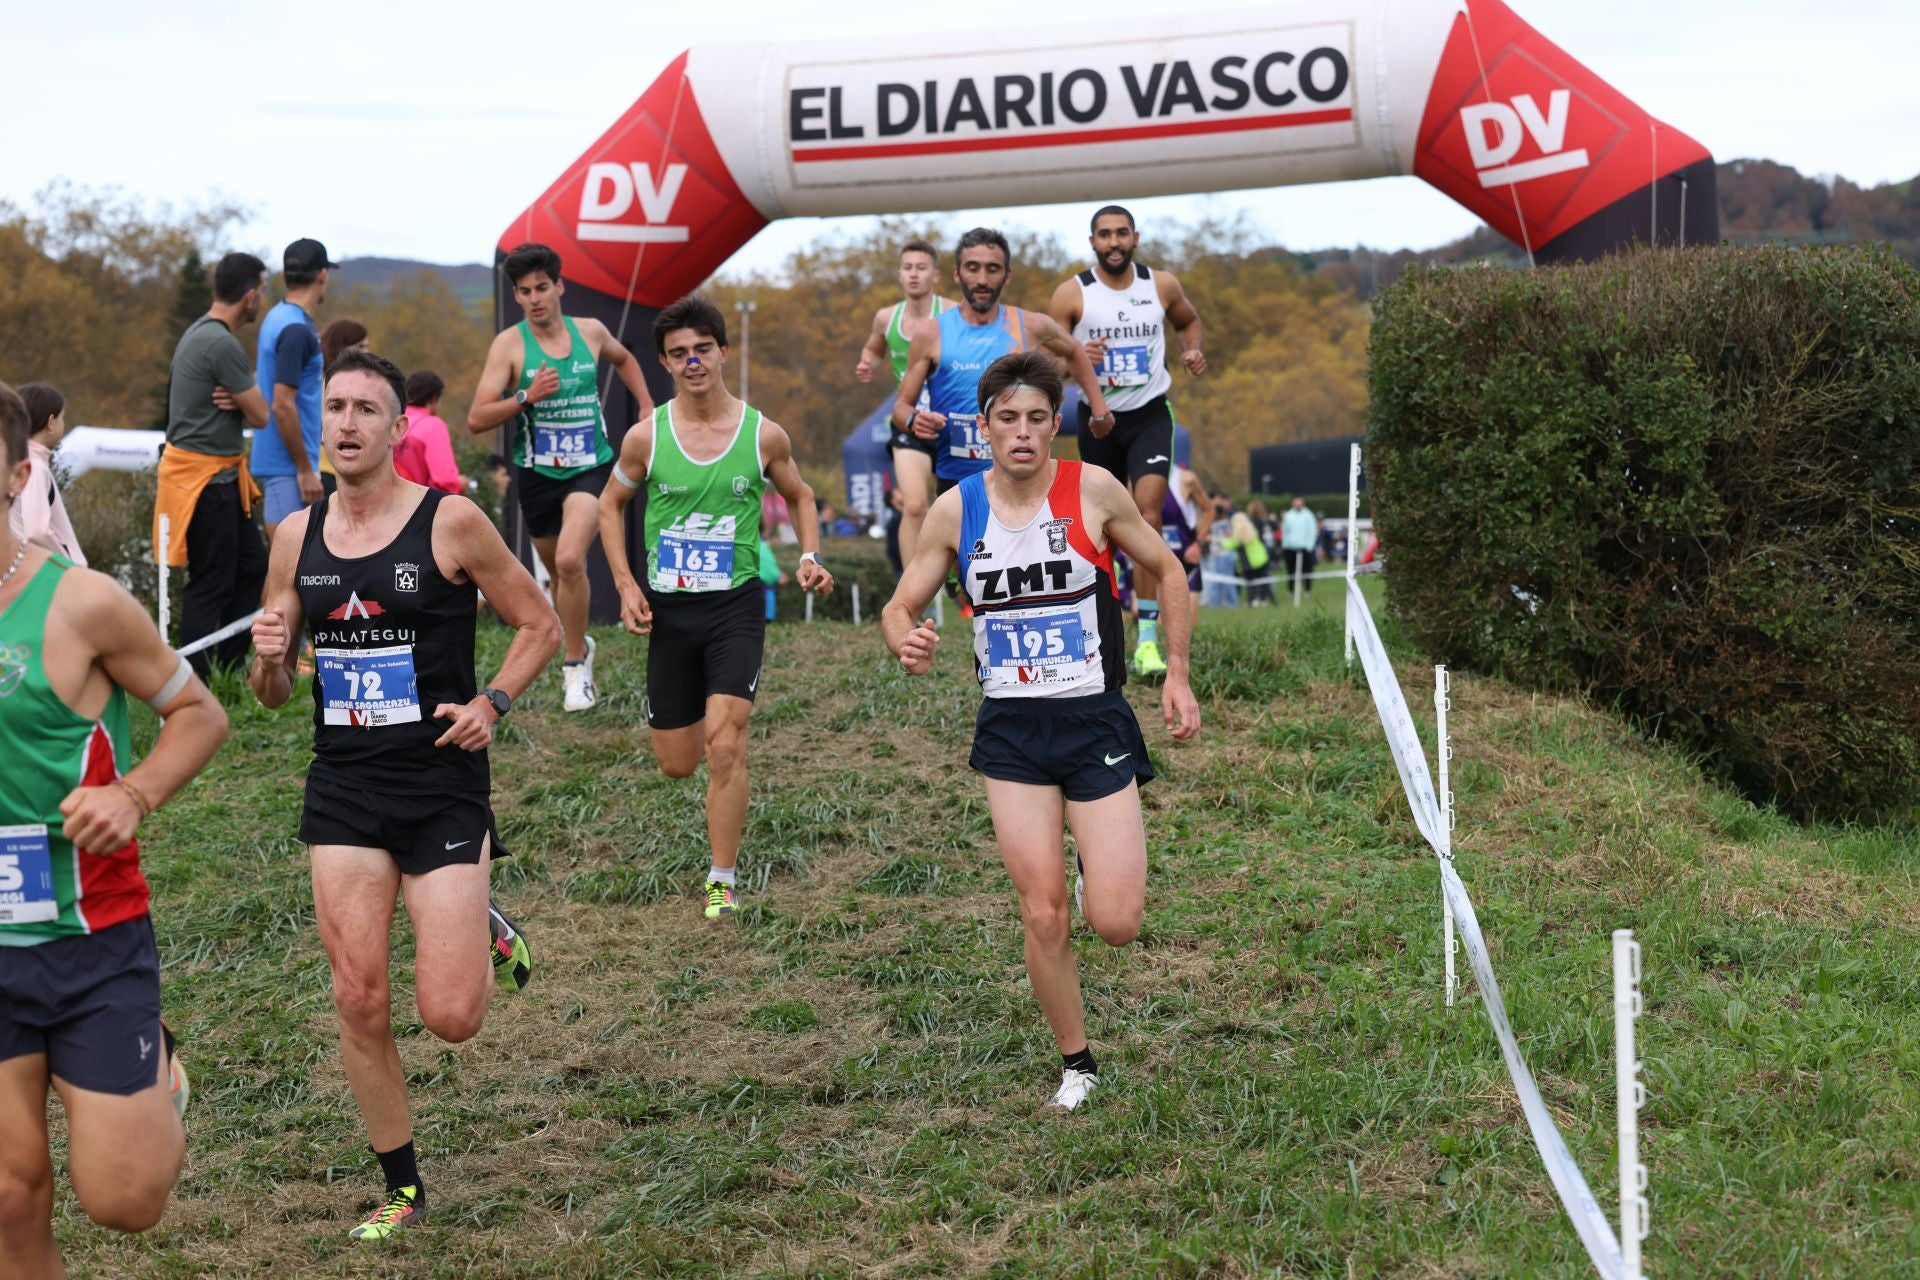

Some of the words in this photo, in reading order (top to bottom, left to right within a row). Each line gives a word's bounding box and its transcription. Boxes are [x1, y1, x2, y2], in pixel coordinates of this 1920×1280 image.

[789, 85, 863, 141] EL
[877, 67, 1107, 137] DIARIO
[1119, 46, 1348, 118] VASCO
[1459, 89, 1570, 170] DV
[578, 161, 688, 224] DV
[1103, 353, 1138, 372] 153
[548, 434, 585, 453] 145
[668, 512, 736, 535] LEA
[673, 547, 718, 571] 163
[967, 552, 992, 560] VIATOR
[300, 575, 341, 586] macron
[976, 559, 1072, 600] ZMT
[991, 623, 1001, 631] 69
[1006, 628, 1065, 658] 195
[324, 661, 333, 669] 69
[1002, 658, 1029, 667] AIMAR
[1031, 654, 1073, 666] SUKUNZA
[343, 671, 384, 700] 72
[329, 700, 354, 710] ANDER
[355, 698, 411, 711] SAGARZAZU
